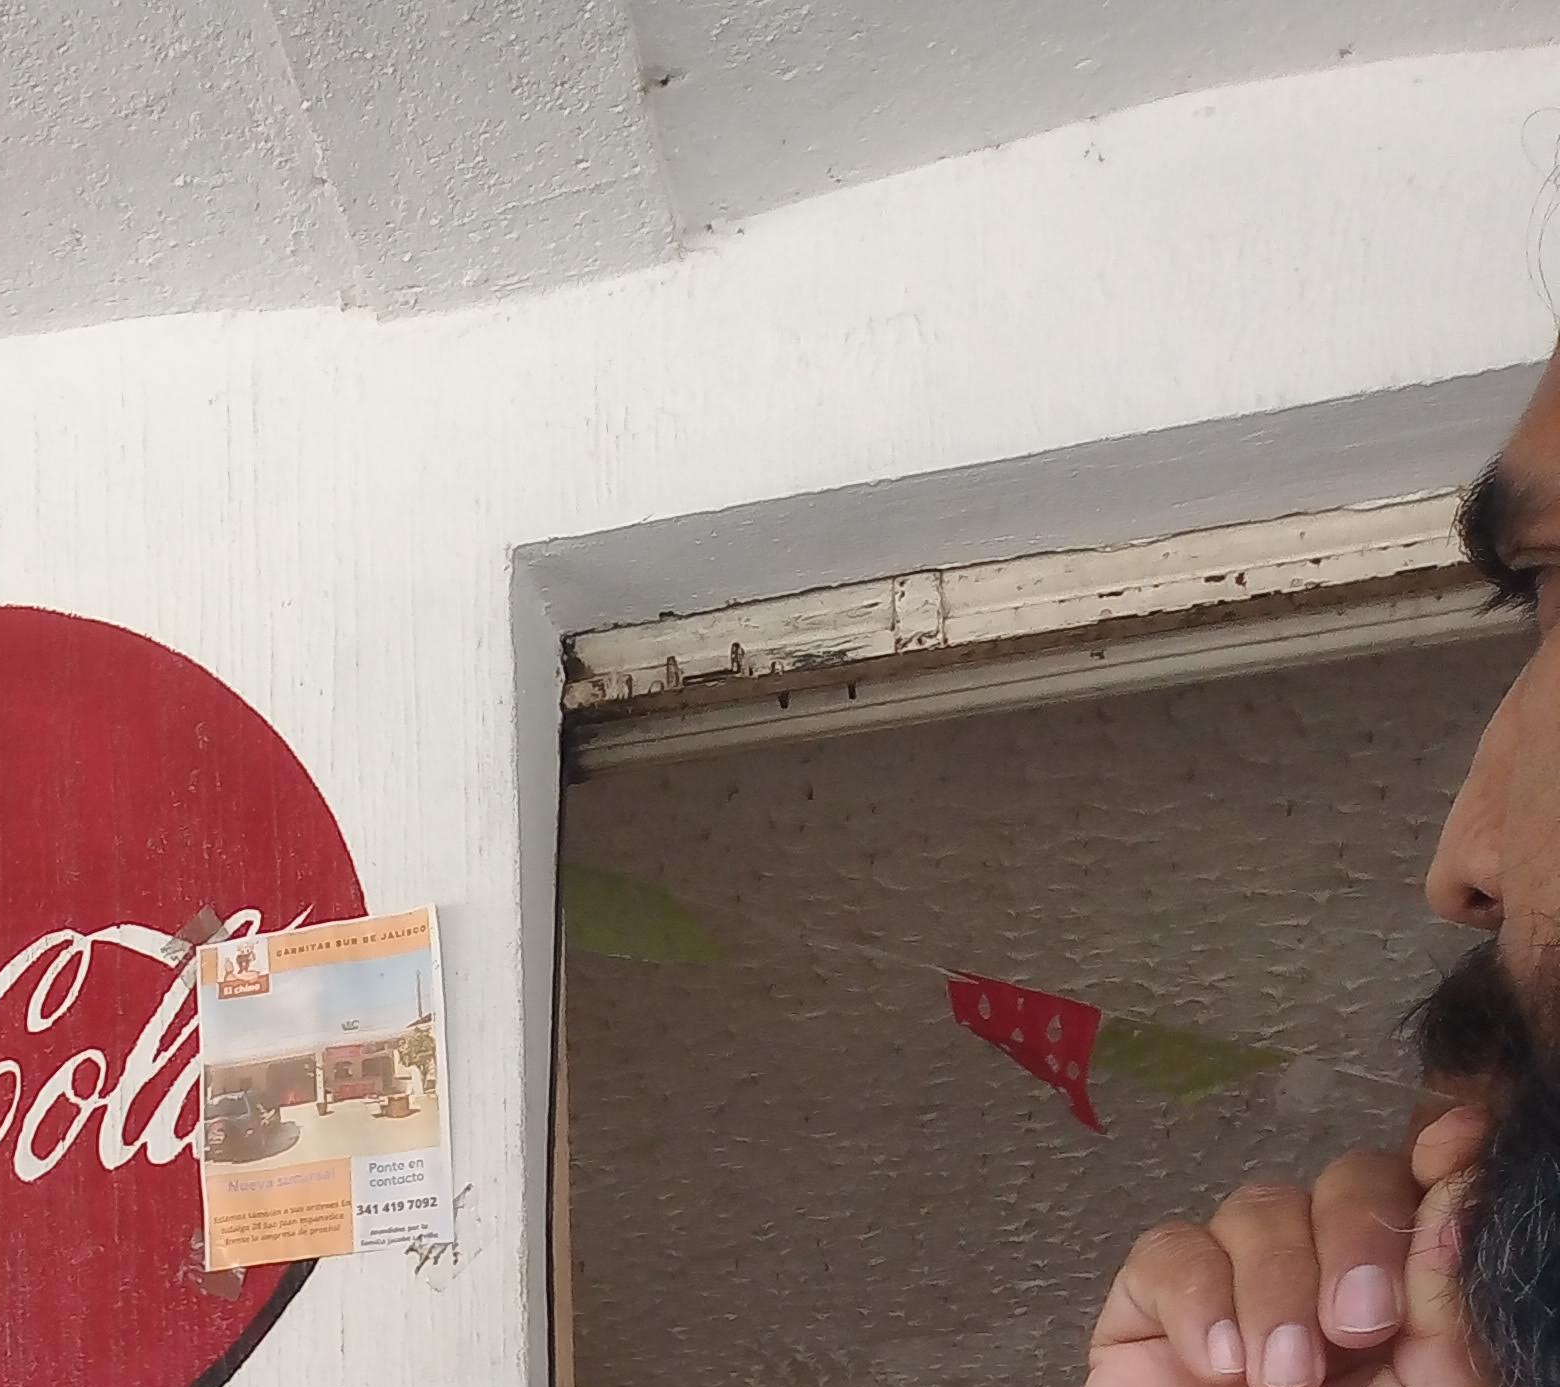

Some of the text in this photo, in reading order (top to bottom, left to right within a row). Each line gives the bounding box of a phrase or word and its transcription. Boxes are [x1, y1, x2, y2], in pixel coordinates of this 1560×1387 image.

[380, 925, 427, 941] JALISCO
[368, 1158, 425, 1175] Ponte en
[228, 1178, 274, 1193] Nueva
[369, 1171, 425, 1188] contacto
[356, 1197, 439, 1216] 341 419 7092
